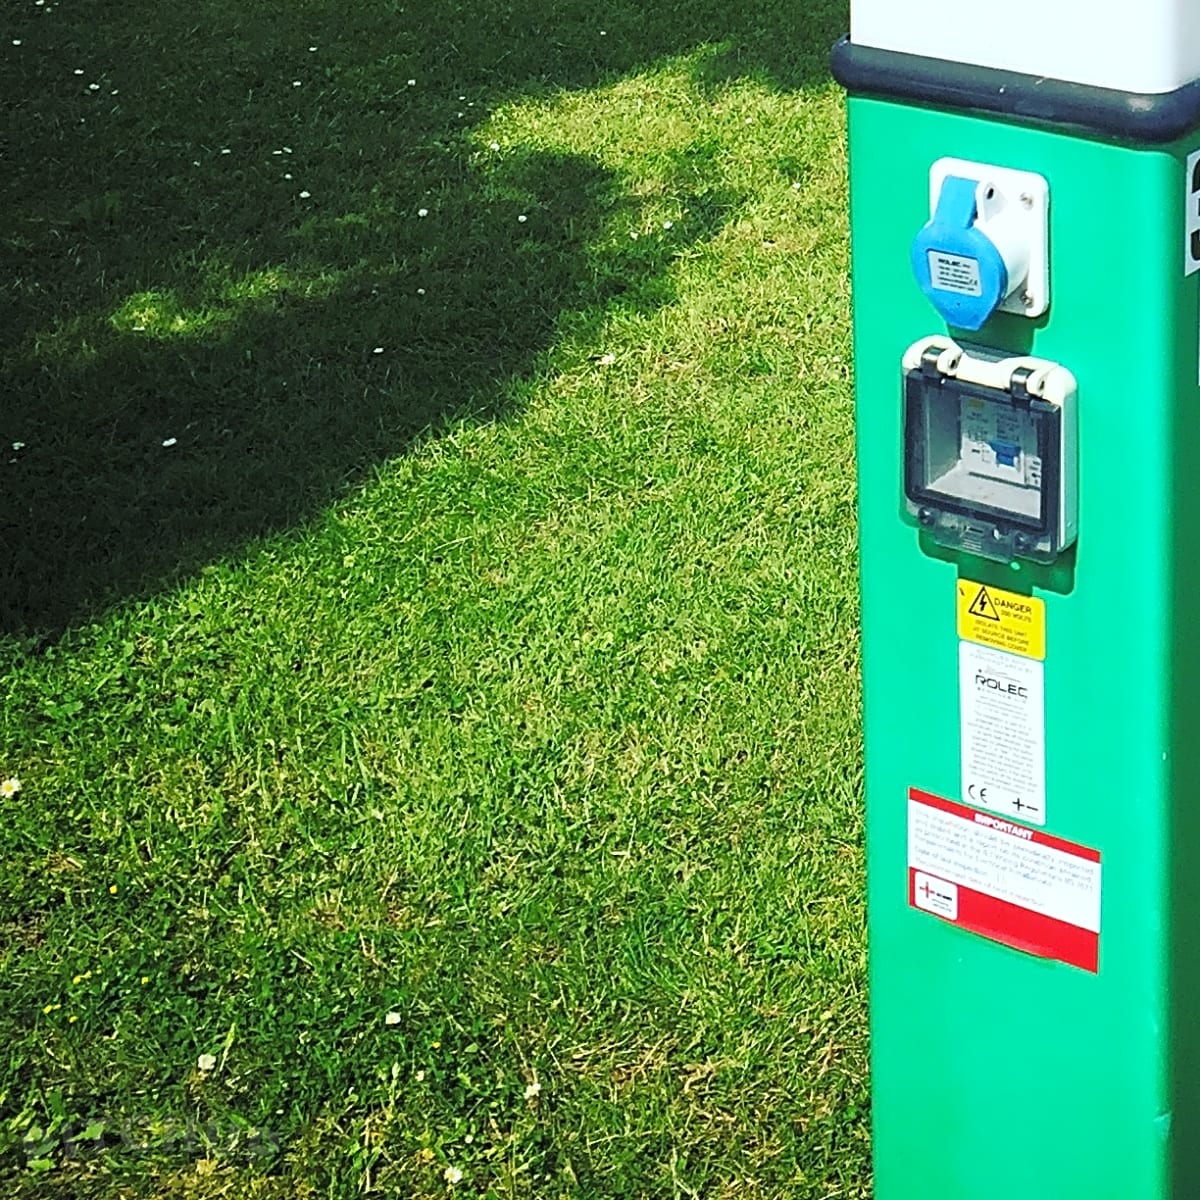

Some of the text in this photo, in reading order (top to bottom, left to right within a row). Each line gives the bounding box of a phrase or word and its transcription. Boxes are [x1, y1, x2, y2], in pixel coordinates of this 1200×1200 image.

[994, 597, 1032, 615] DANGER
[975, 673, 1028, 699] ROLEC
[974, 812, 1034, 841] IMPORTANT
